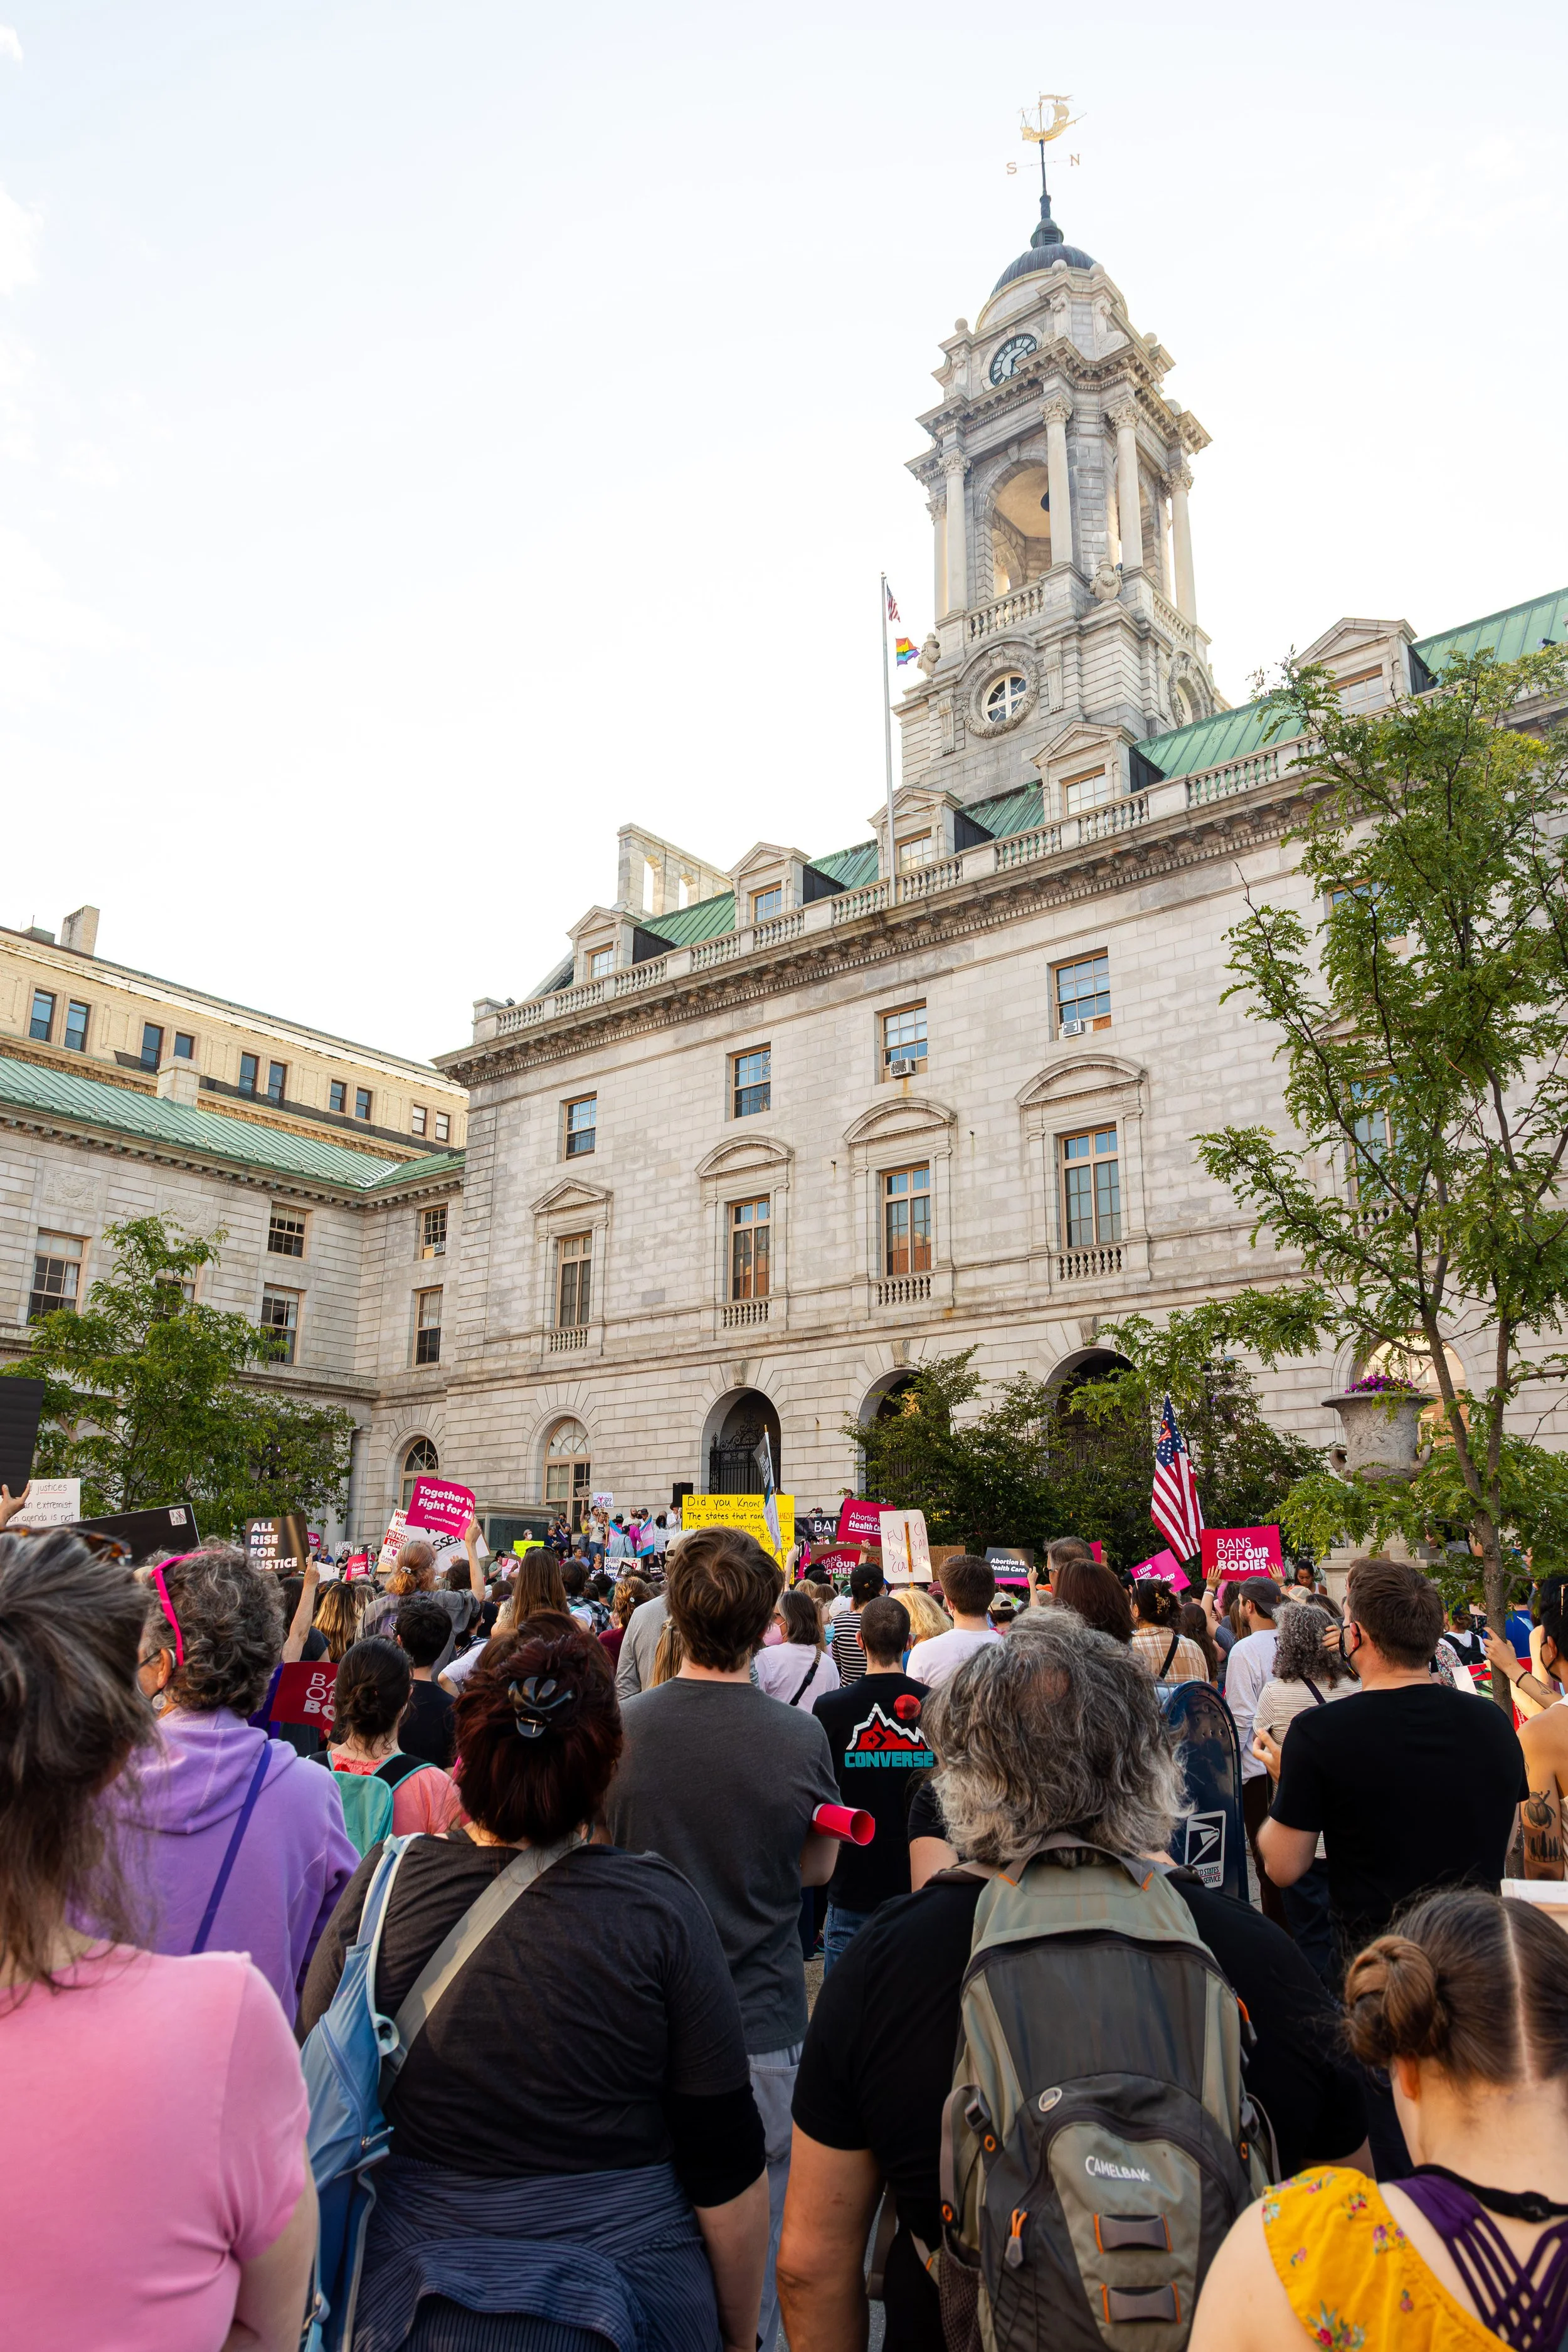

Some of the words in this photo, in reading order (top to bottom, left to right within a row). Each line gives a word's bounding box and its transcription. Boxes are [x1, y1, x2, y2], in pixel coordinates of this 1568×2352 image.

[36, 1482, 67, 1495] justices
[420, 1485, 465, 1504] Together
[37, 1501, 72, 1509] extremist
[418, 1498, 445, 1511] Fight
[447, 1503, 462, 1515] for
[687, 1496, 706, 1507] Did
[714, 1500, 731, 1510] you
[22, 1513, 47, 1526] agenda
[61, 1512, 75, 1522] not
[706, 1512, 729, 1520] states
[732, 1512, 747, 1520] that
[850, 1512, 877, 1522] Abortion
[251, 1523, 274, 1532] ALL
[849, 1520, 873, 1530] Health
[251, 1535, 278, 1545] RISE
[388, 1530, 408, 1542] HUMAN
[1217, 1537, 1252, 1549] BANS
[250, 1547, 276, 1557] FOR
[1217, 1549, 1243, 1560] OFF
[1244, 1547, 1269, 1560] OUR
[822, 1555, 842, 1565] BANS
[1218, 1559, 1266, 1571] BODIES
[1139, 1564, 1153, 1575] STAND
[844, 1751, 934, 1768] CONVERSE
[1204, 1866, 1219, 1875] STATES
[1204, 1875, 1221, 1884] SERVICE
[1085, 2155, 1150, 2182] CAMELBAK
